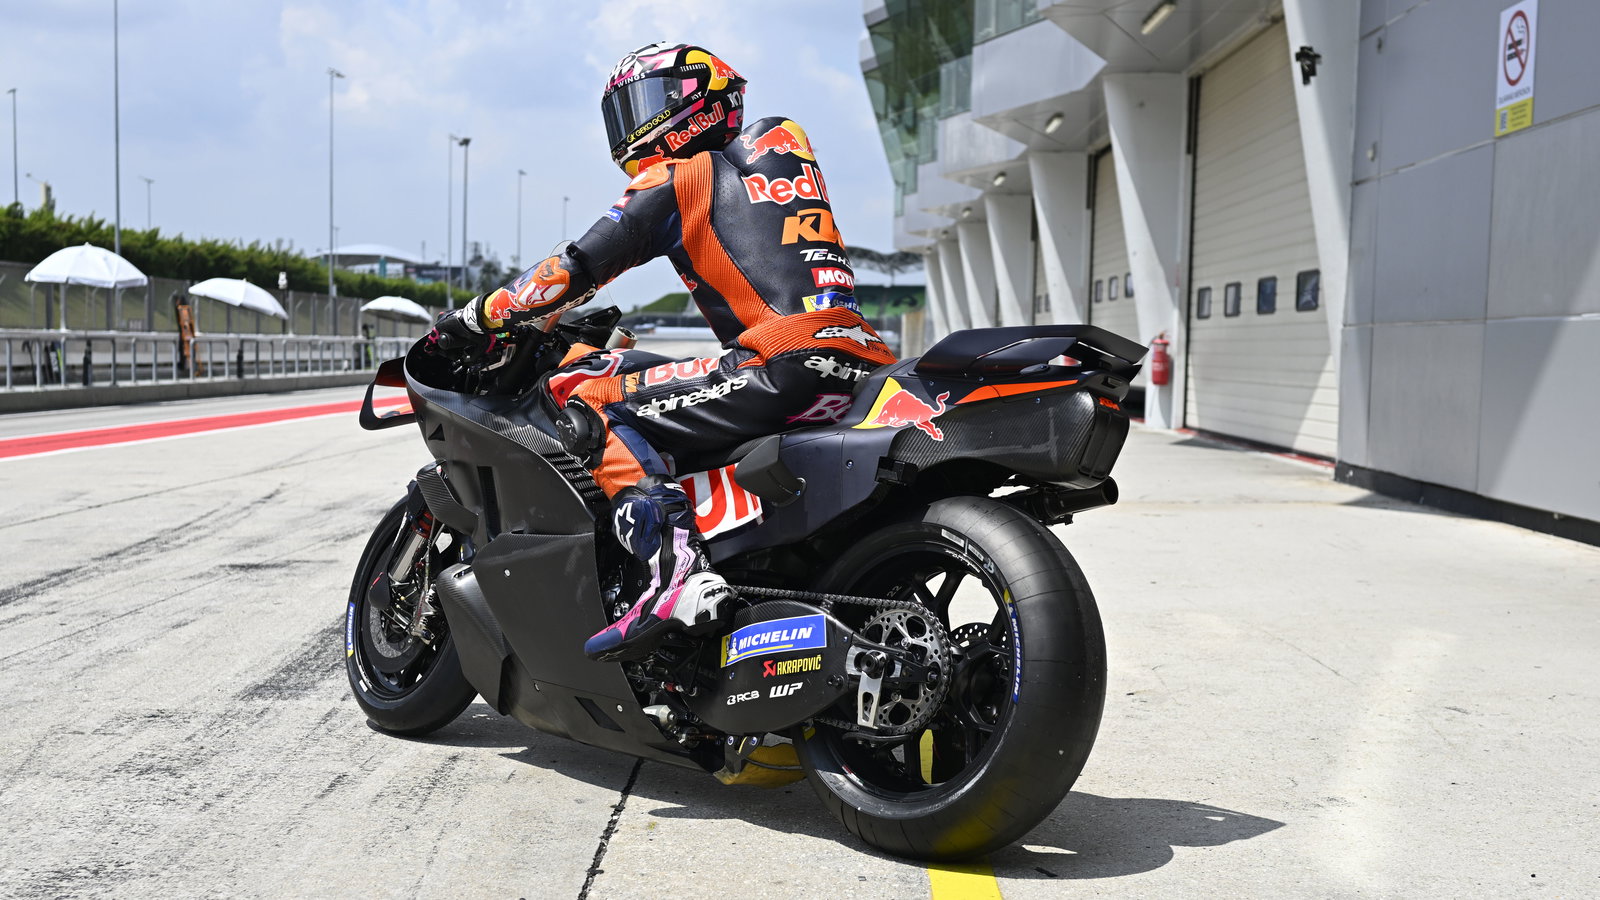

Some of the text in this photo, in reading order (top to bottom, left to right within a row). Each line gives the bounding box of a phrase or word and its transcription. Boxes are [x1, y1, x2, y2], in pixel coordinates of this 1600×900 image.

[617, 73, 646, 88] WINGS
[652, 109, 671, 125] GOLD
[664, 116, 703, 152] Red
[693, 101, 725, 131] Bull
[741, 163, 821, 204] Red
[818, 270, 854, 287] MOT
[637, 374, 750, 419] alpinestars
[738, 627, 813, 650] MICHELIN
[769, 682, 803, 698] WP
